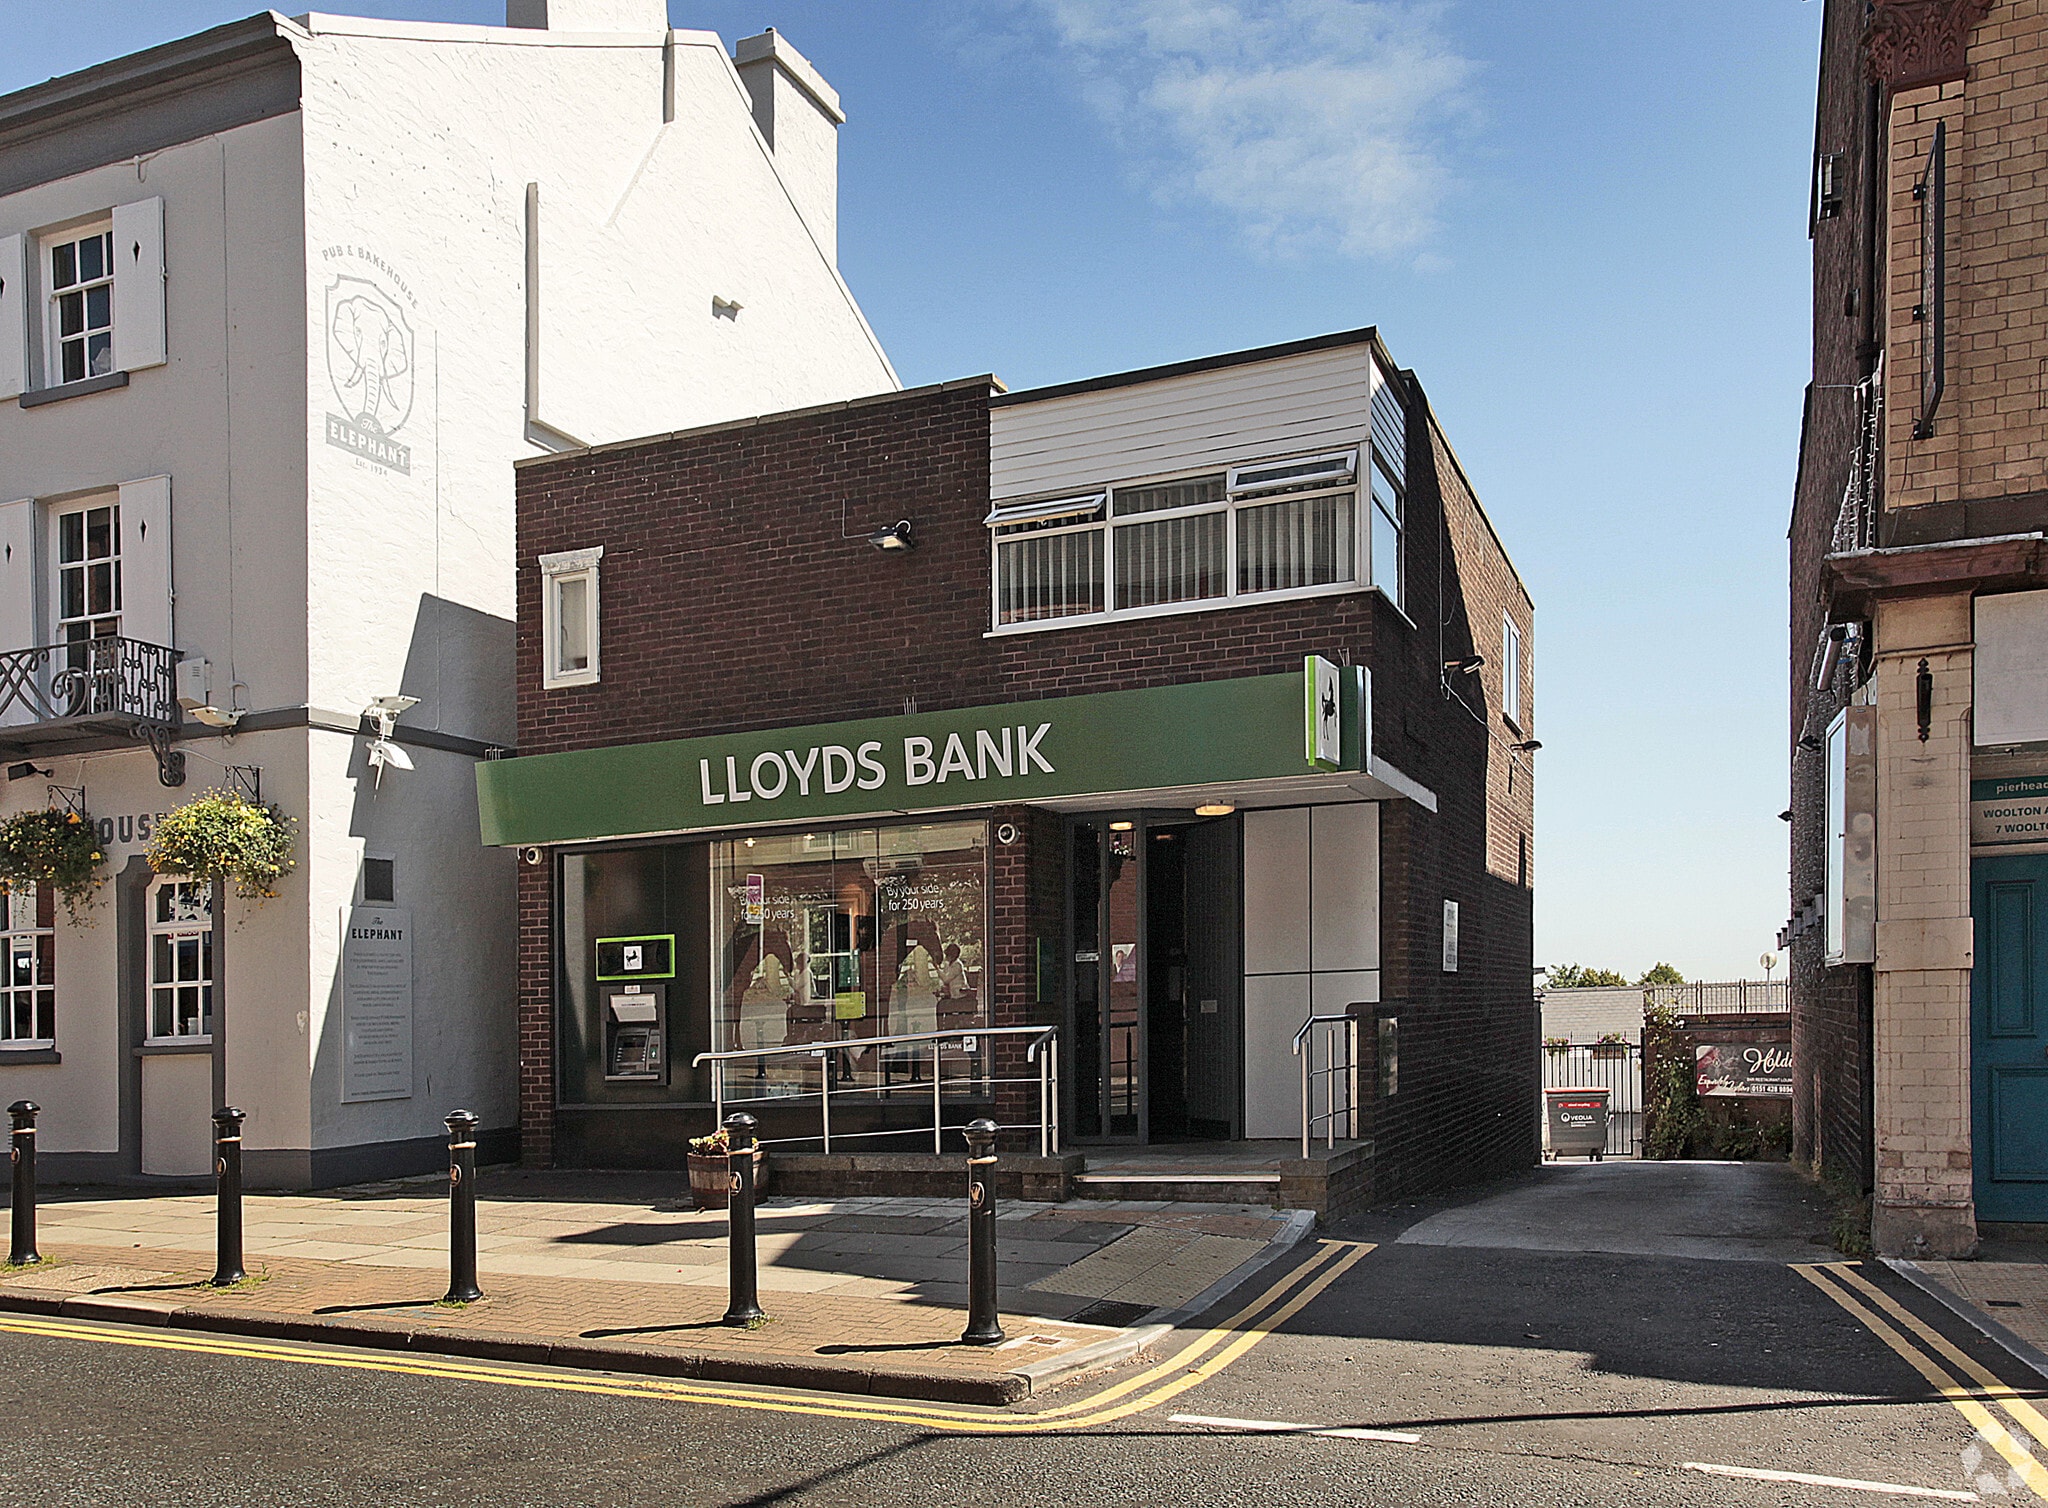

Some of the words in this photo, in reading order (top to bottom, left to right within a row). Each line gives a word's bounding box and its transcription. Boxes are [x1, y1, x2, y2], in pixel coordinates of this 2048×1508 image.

[322, 245, 343, 261] PUB
[347, 245, 354, 256] &
[358, 247, 418, 309] BAKEHOUSE
[360, 418, 378, 434] The
[330, 421, 406, 467] ELEPHANT
[700, 741, 886, 805] LLOYDS
[904, 723, 1055, 786] BANK
[1983, 806, 2041, 818] WOOLTON
[92, 812, 168, 845] OUS
[1995, 825, 2002, 834] 7
[886, 886, 899, 898] By
[900, 885, 919, 898] your
[889, 900, 900, 911] for
[902, 898, 919, 910] 250
[920, 899, 944, 912] years
[771, 908, 794, 922] years
[352, 928, 403, 940] ELEPHANT
[928, 1042, 947, 1050] LLDS
